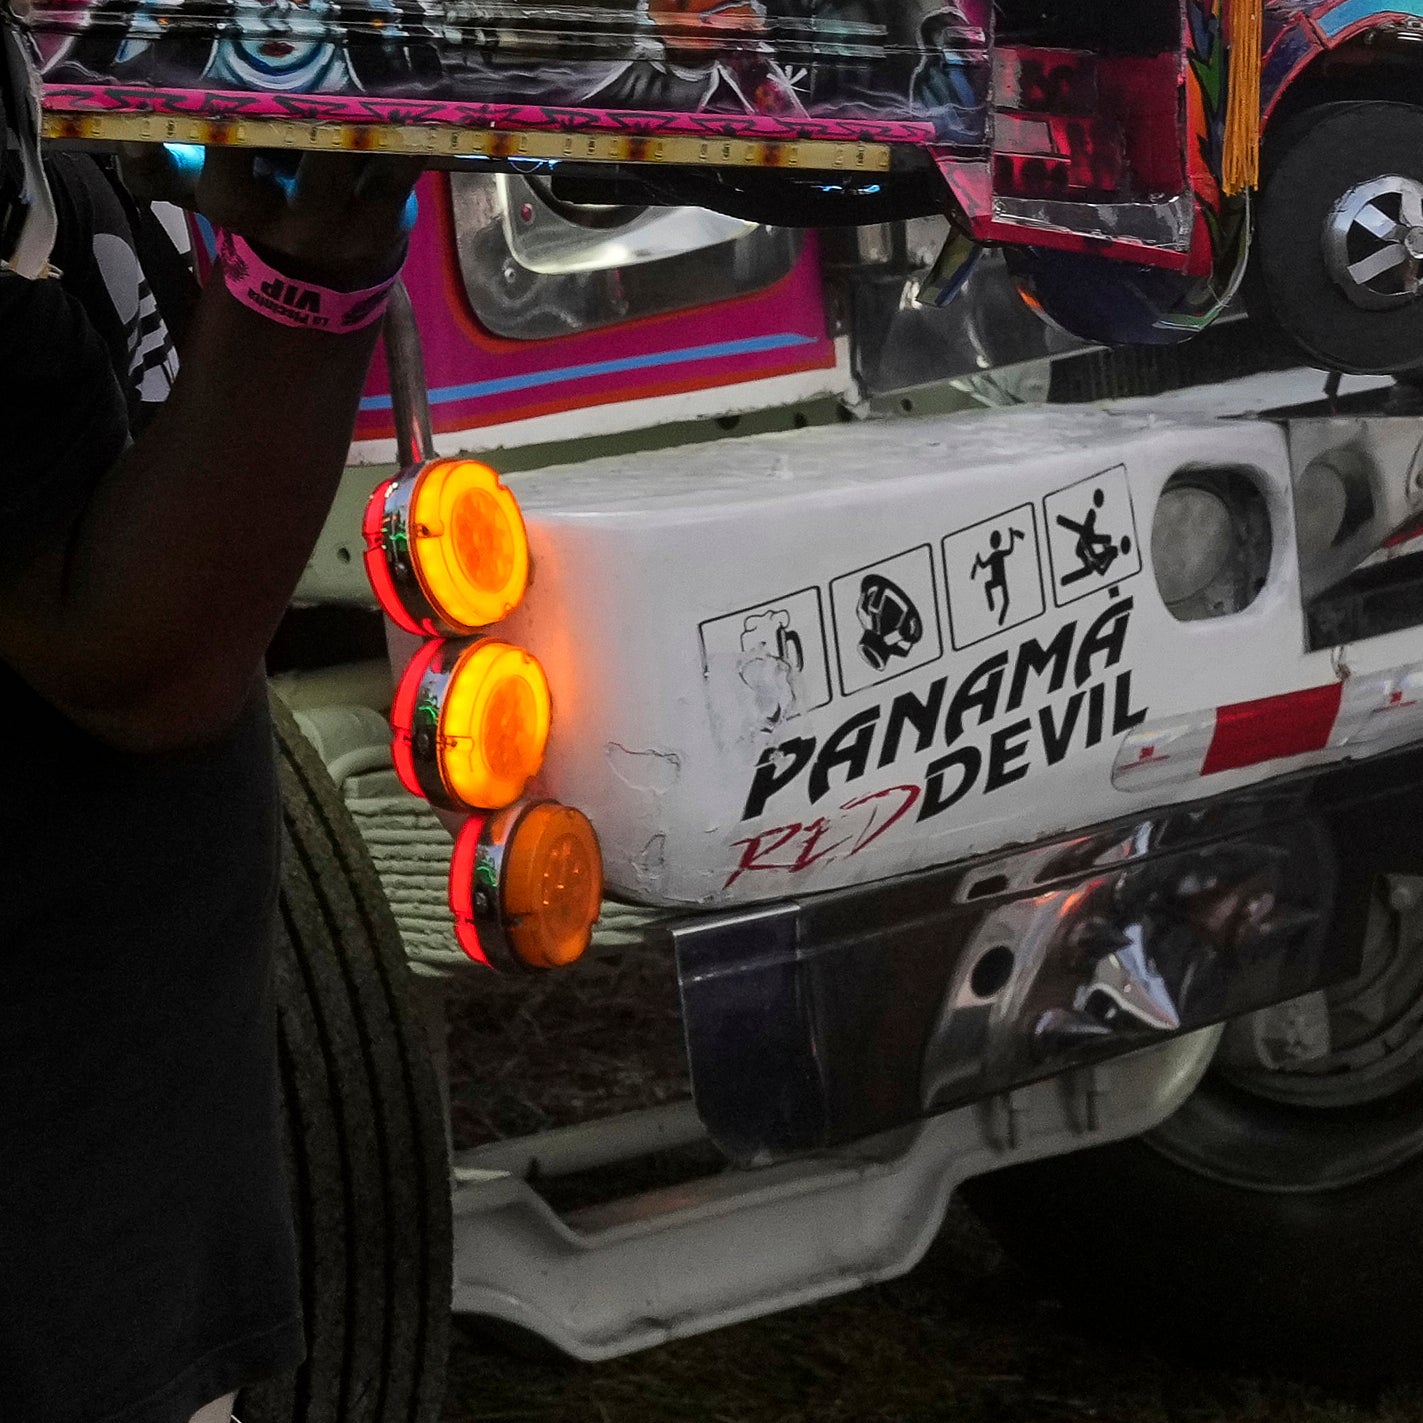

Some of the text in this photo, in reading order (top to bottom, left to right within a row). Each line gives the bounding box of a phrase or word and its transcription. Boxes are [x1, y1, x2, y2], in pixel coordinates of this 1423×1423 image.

[261, 278, 322, 314] VIP
[723, 669, 1150, 890] RED DEVIL
[741, 584, 1136, 822] PANAMÁ
